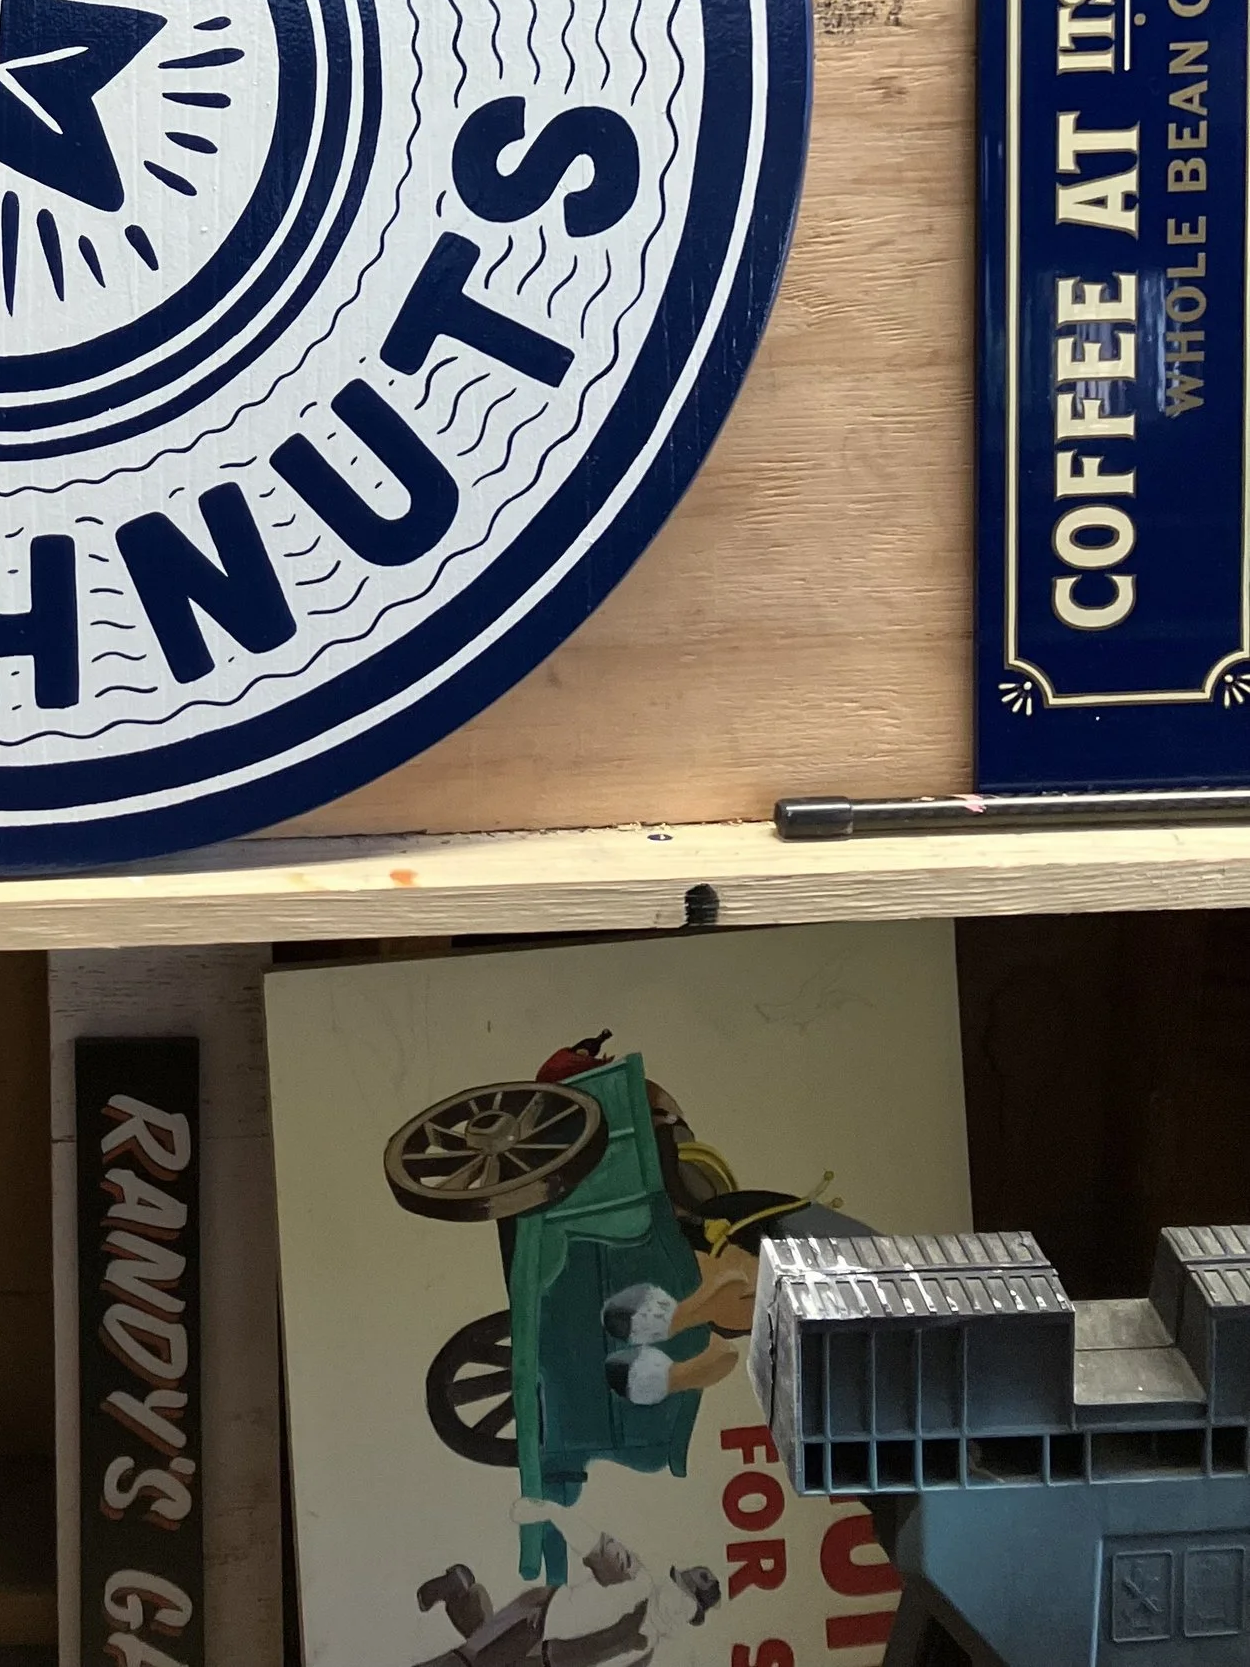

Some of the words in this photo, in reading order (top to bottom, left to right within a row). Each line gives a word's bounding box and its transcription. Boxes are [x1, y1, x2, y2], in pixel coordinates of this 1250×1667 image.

[1055, 110, 1141, 238] AT
[1166, 39, 1210, 193] BEAN
[1165, 213, 1208, 418] WHOLE
[1053, 271, 1140, 631] COFFEE
[100, 1093, 196, 1530] RANDY'S
[720, 1425, 787, 1600] FOR
